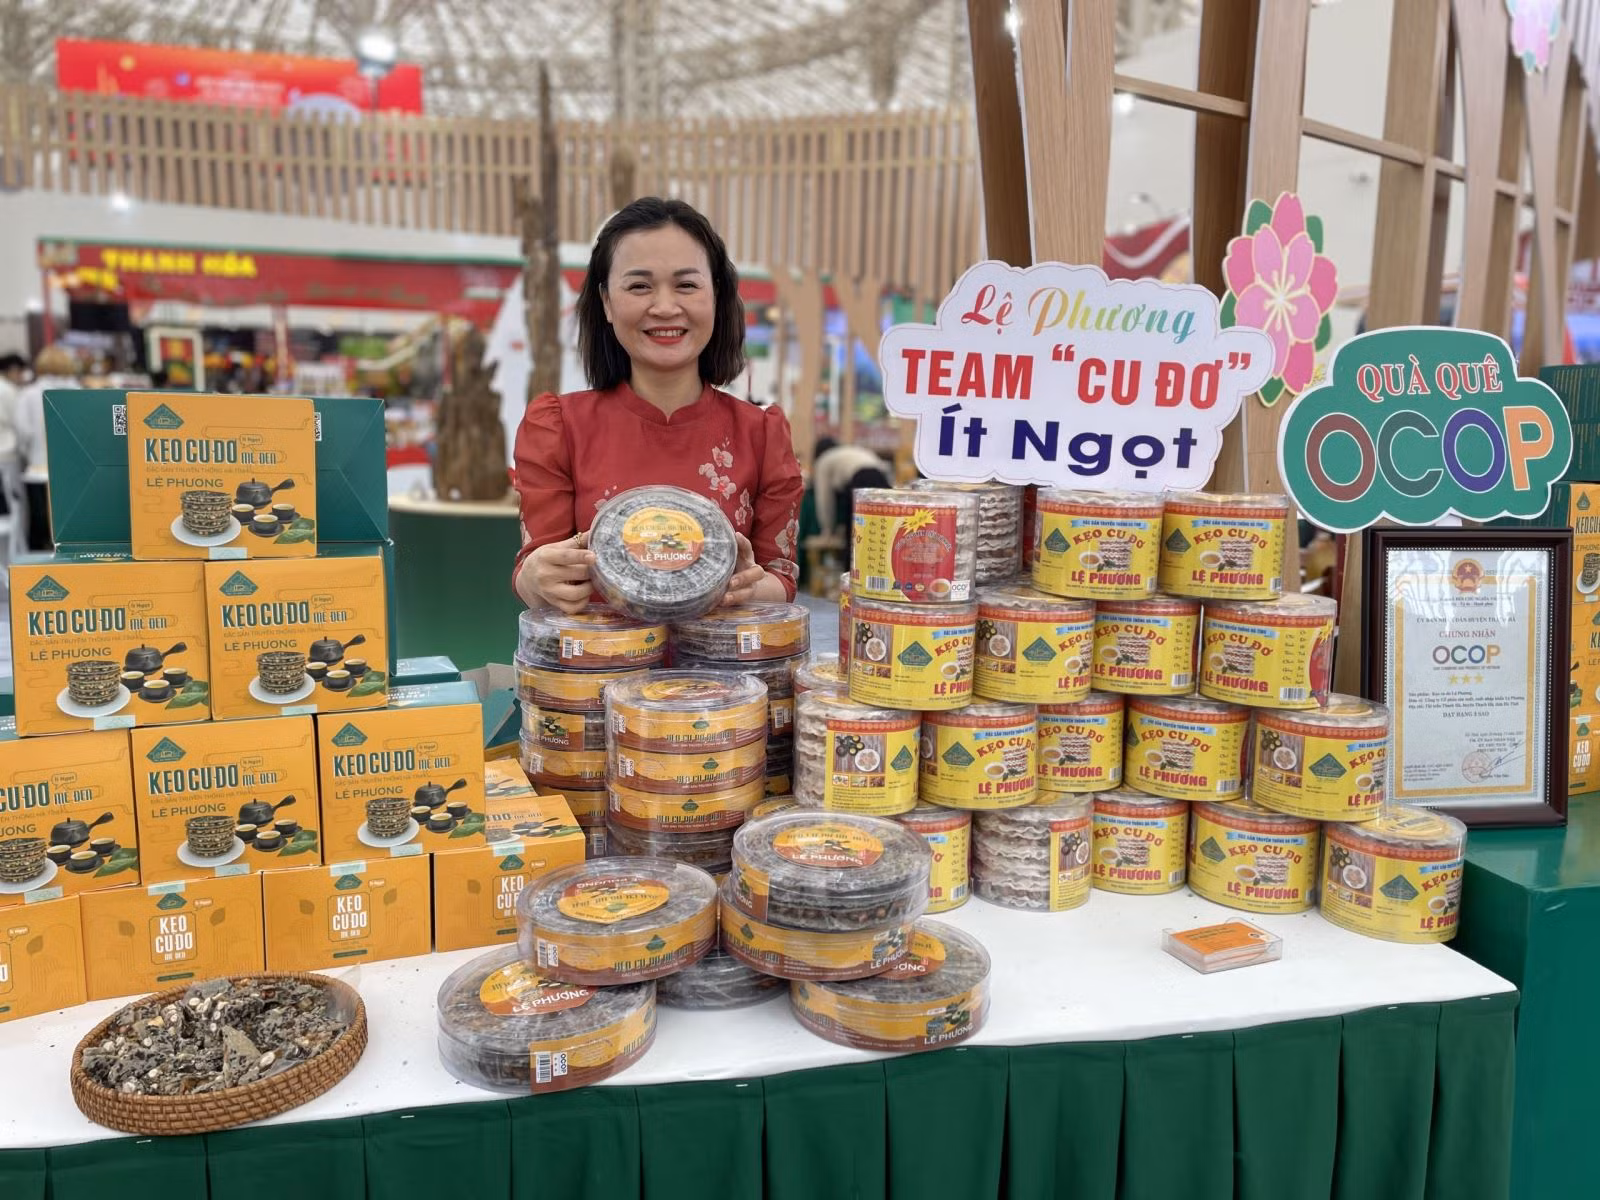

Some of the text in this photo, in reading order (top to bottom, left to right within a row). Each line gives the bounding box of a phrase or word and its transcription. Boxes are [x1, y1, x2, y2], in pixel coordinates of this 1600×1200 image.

[961, 284, 1196, 345] Lệ Phương
[902, 348, 1034, 401] TEAM
[1356, 353, 1503, 403] QUÀ QUÊ
[938, 402, 1198, 479] Ít Ngọt
[1305, 405, 1554, 503] OCOP
[1089, 572, 1141, 585] PHƯƠNG
[1210, 571, 1263, 585] PHƯƠNG
[1433, 644, 1501, 665] OCOP
[1108, 665, 1163, 680] PHƯƠNG
[1052, 766, 1102, 778] PHƯƠNG
[1153, 769, 1208, 787] PHƯƠNG
[978, 781, 992, 796] LỆ
[1245, 885, 1299, 899] PHƯƠNG
[533, 988, 590, 1008] PHƯƠNG
[938, 1022, 974, 1042] PHƯƠNG
